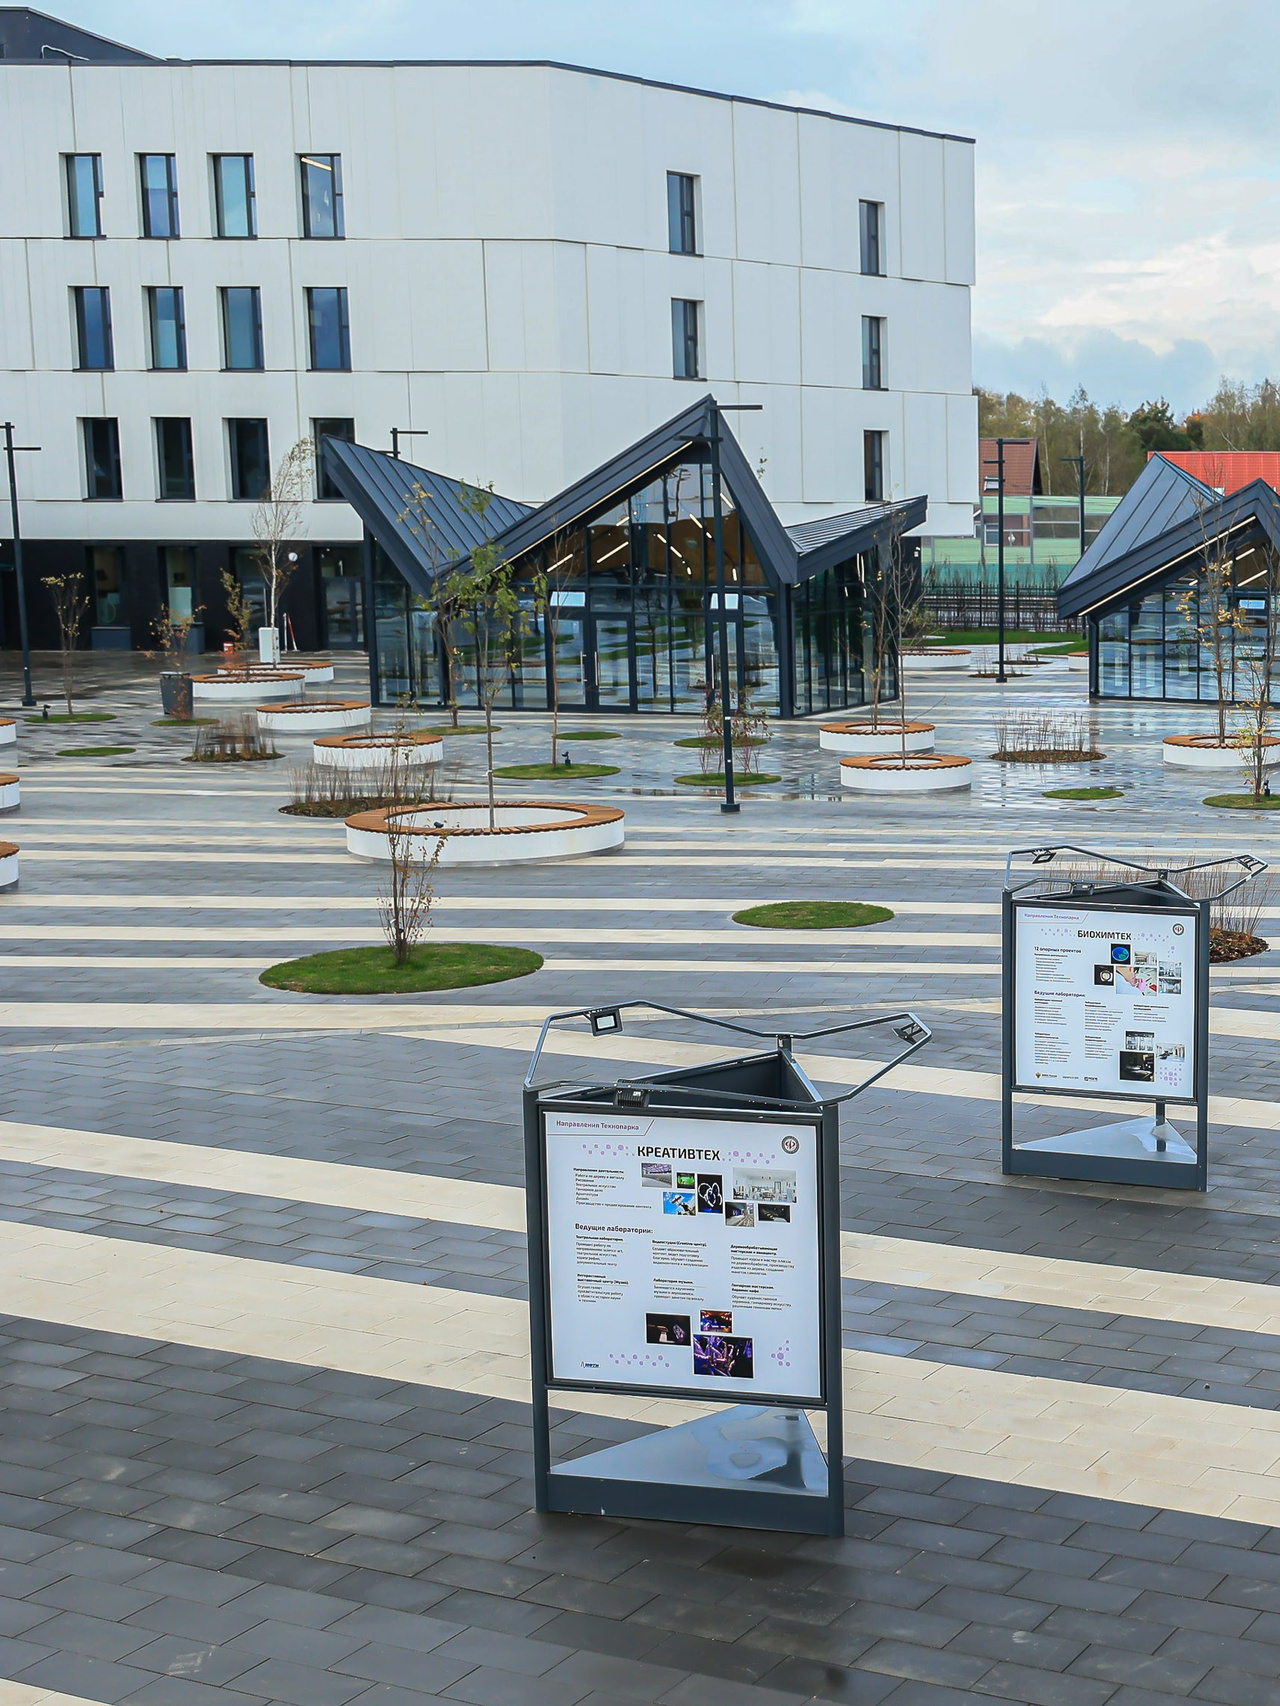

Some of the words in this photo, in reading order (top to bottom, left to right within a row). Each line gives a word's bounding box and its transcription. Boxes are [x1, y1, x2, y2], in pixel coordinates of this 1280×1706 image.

[1077, 930, 1132, 940] БИОХИМТЕХ
[637, 1146, 720, 1161] КРЕАТИВТЕХ
[575, 1223, 605, 1232] Ведущие
[607, 1226, 653, 1234] лаборатории:
